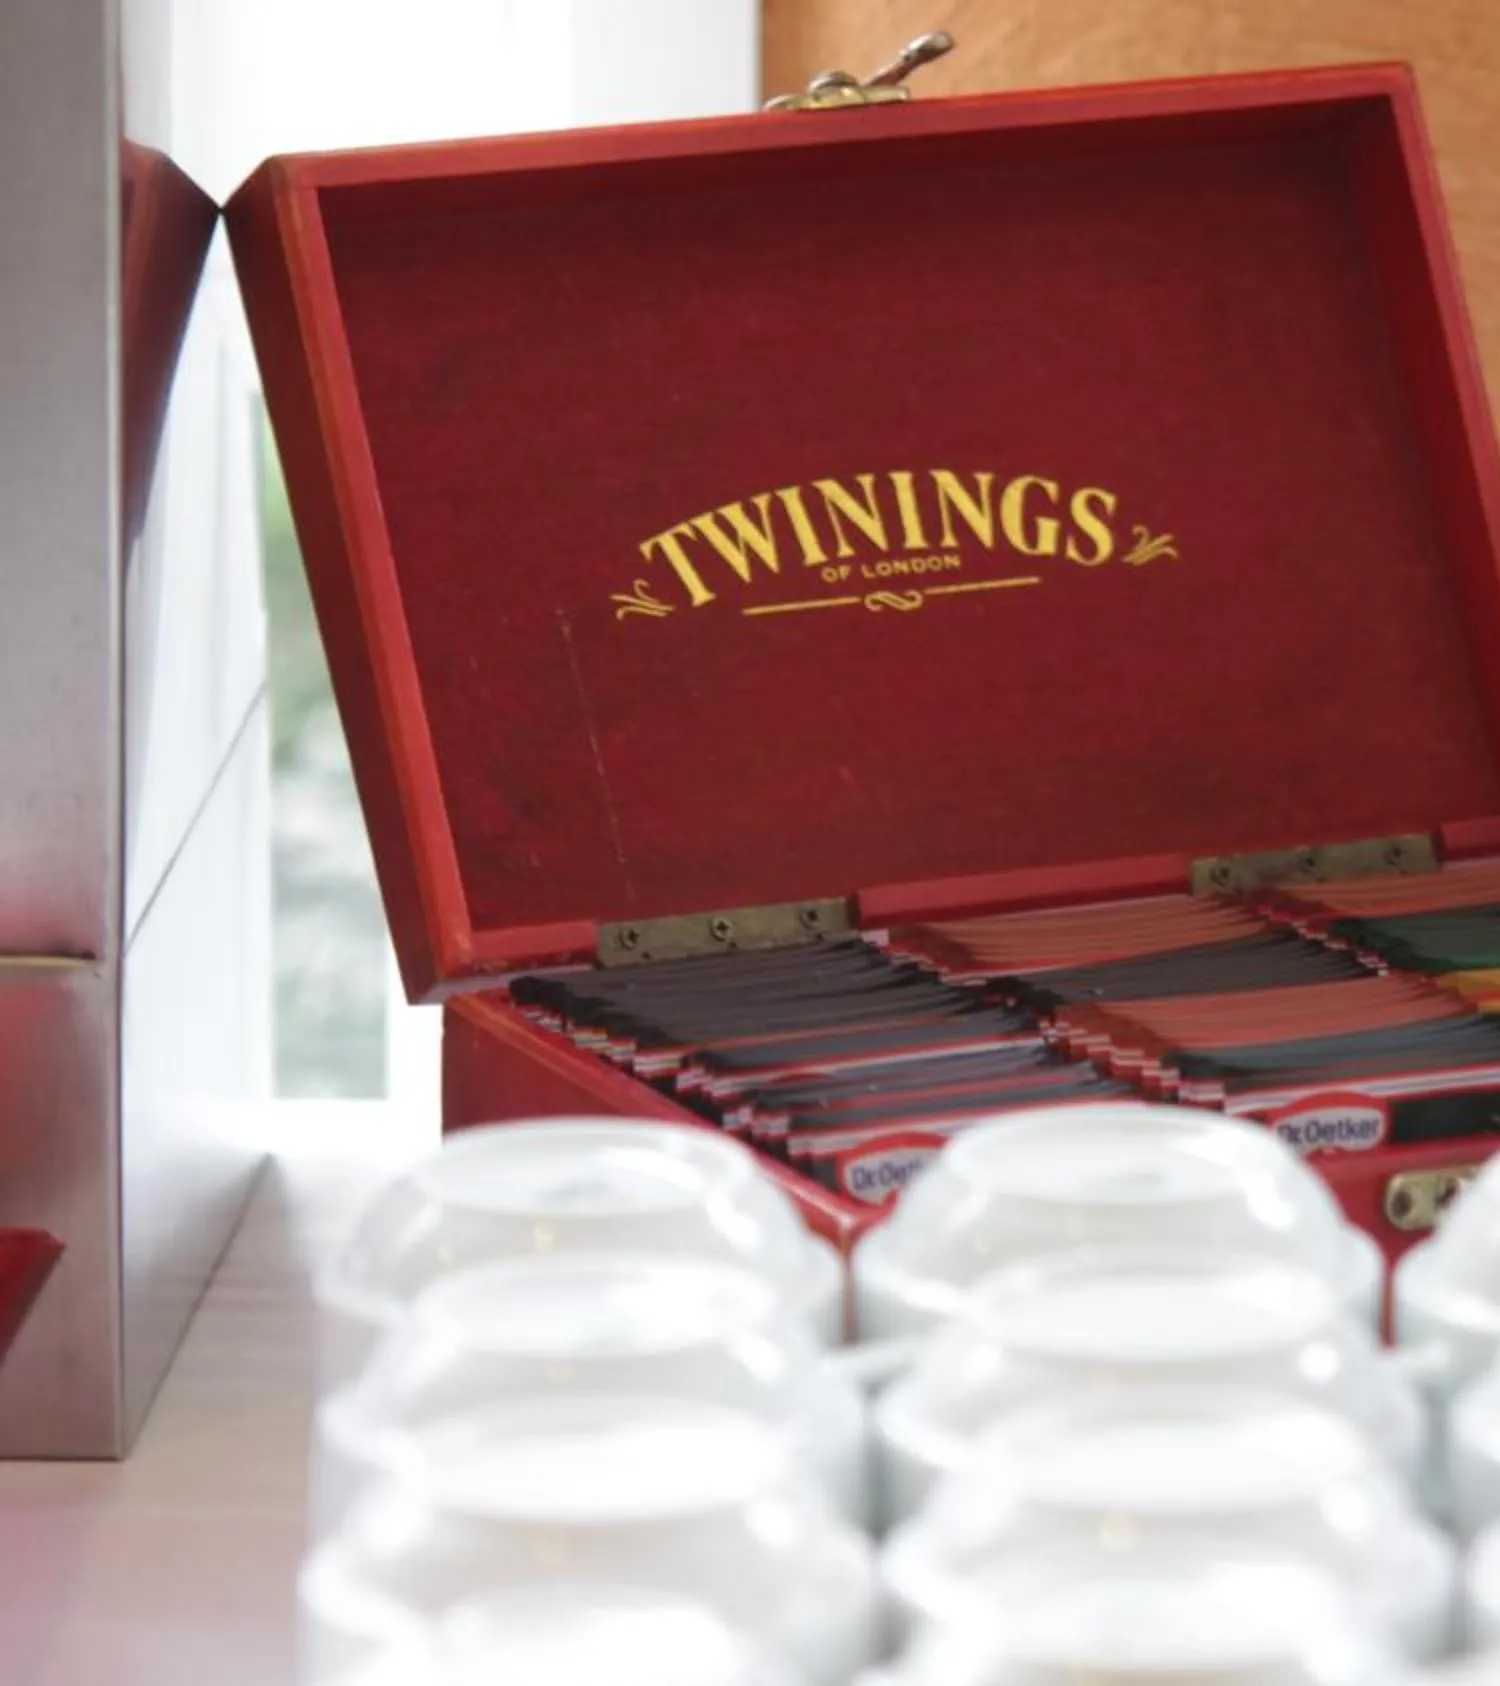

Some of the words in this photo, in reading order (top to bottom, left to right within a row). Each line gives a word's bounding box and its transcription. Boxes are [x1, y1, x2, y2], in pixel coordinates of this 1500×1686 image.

[640, 470, 1117, 606] TWININGS
[821, 565, 850, 583] OF
[861, 554, 960, 579] LONDON
